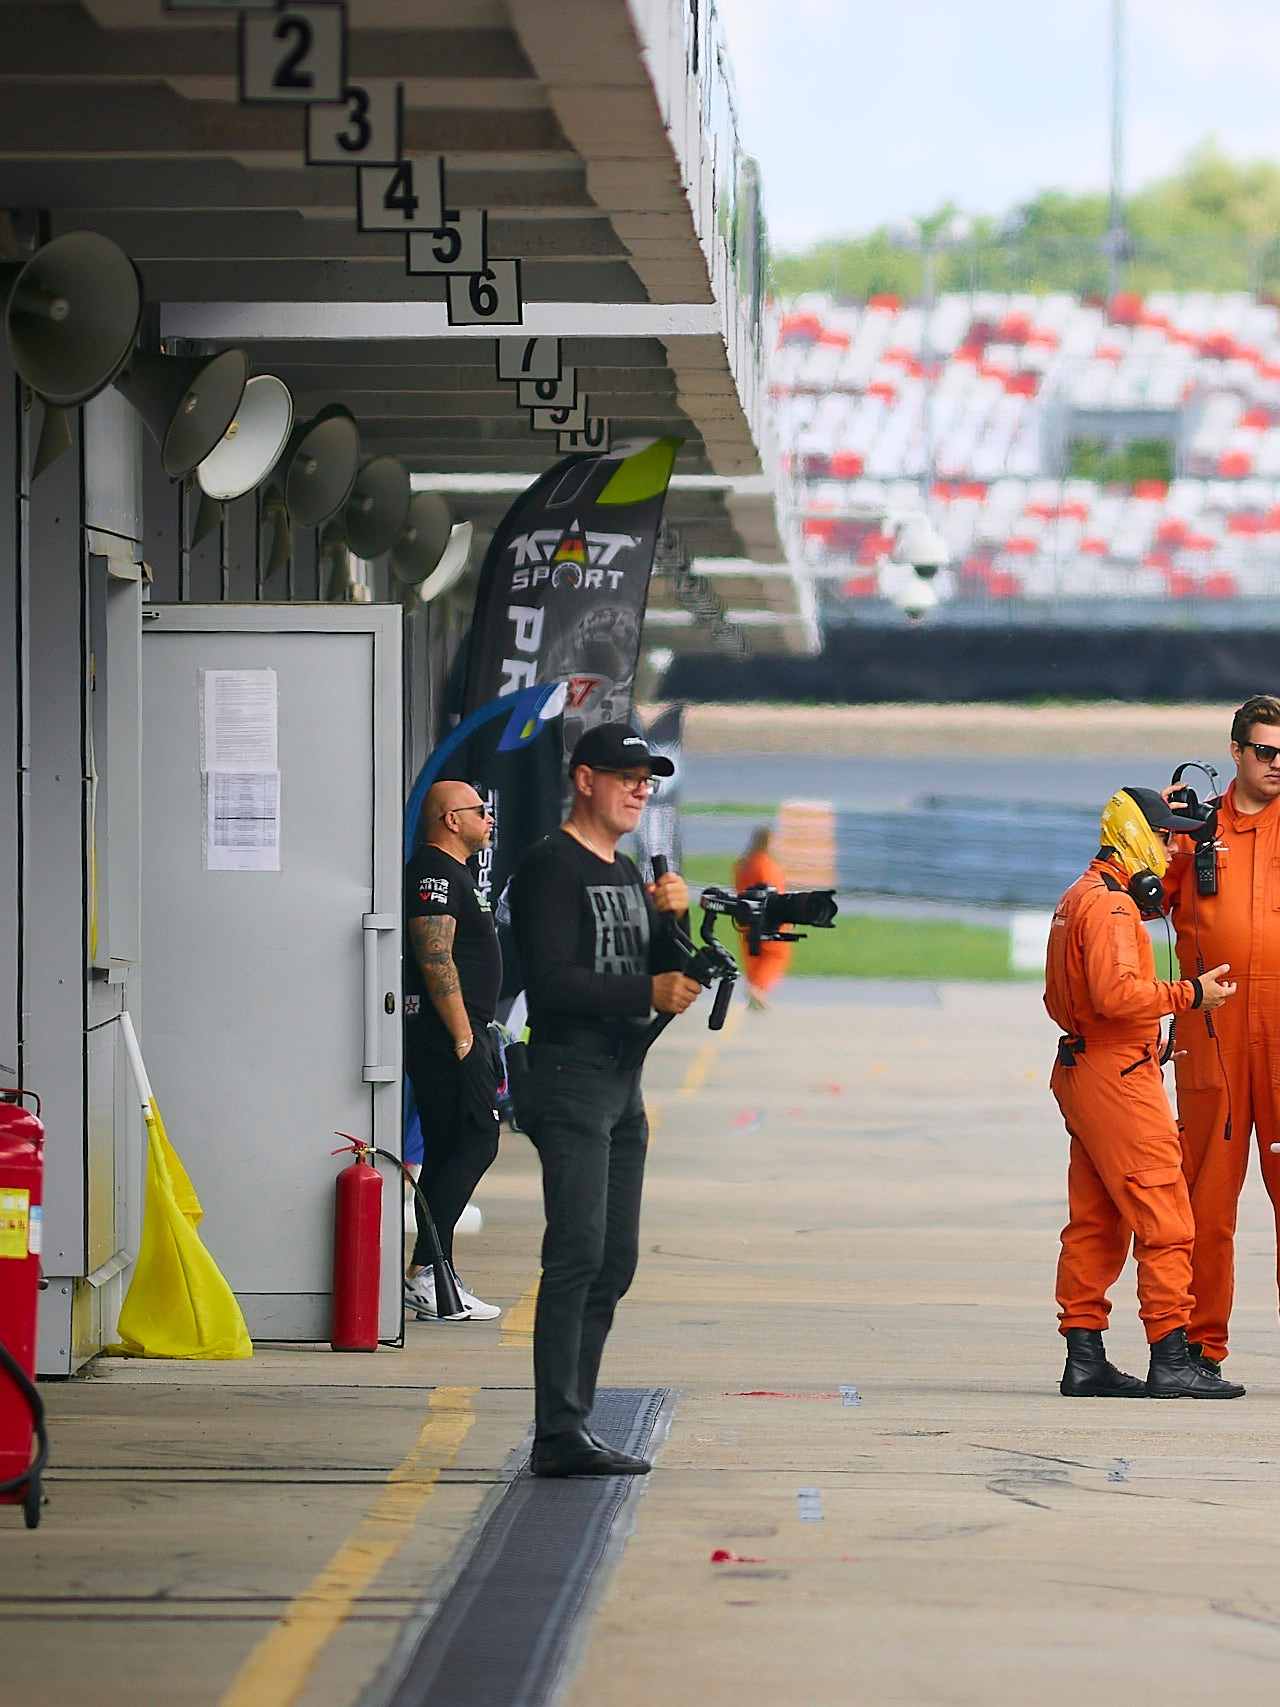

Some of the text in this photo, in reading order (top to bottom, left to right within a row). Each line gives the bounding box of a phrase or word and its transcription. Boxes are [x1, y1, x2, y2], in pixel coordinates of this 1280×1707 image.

[272, 13, 314, 88] 2
[335, 85, 371, 152] 3
[383, 161, 418, 219] 4
[432, 210, 461, 264] 5
[469, 268, 499, 316] 6
[521, 338, 538, 372] 7
[507, 518, 637, 566] KAT
[511, 562, 625, 591] SPORT
